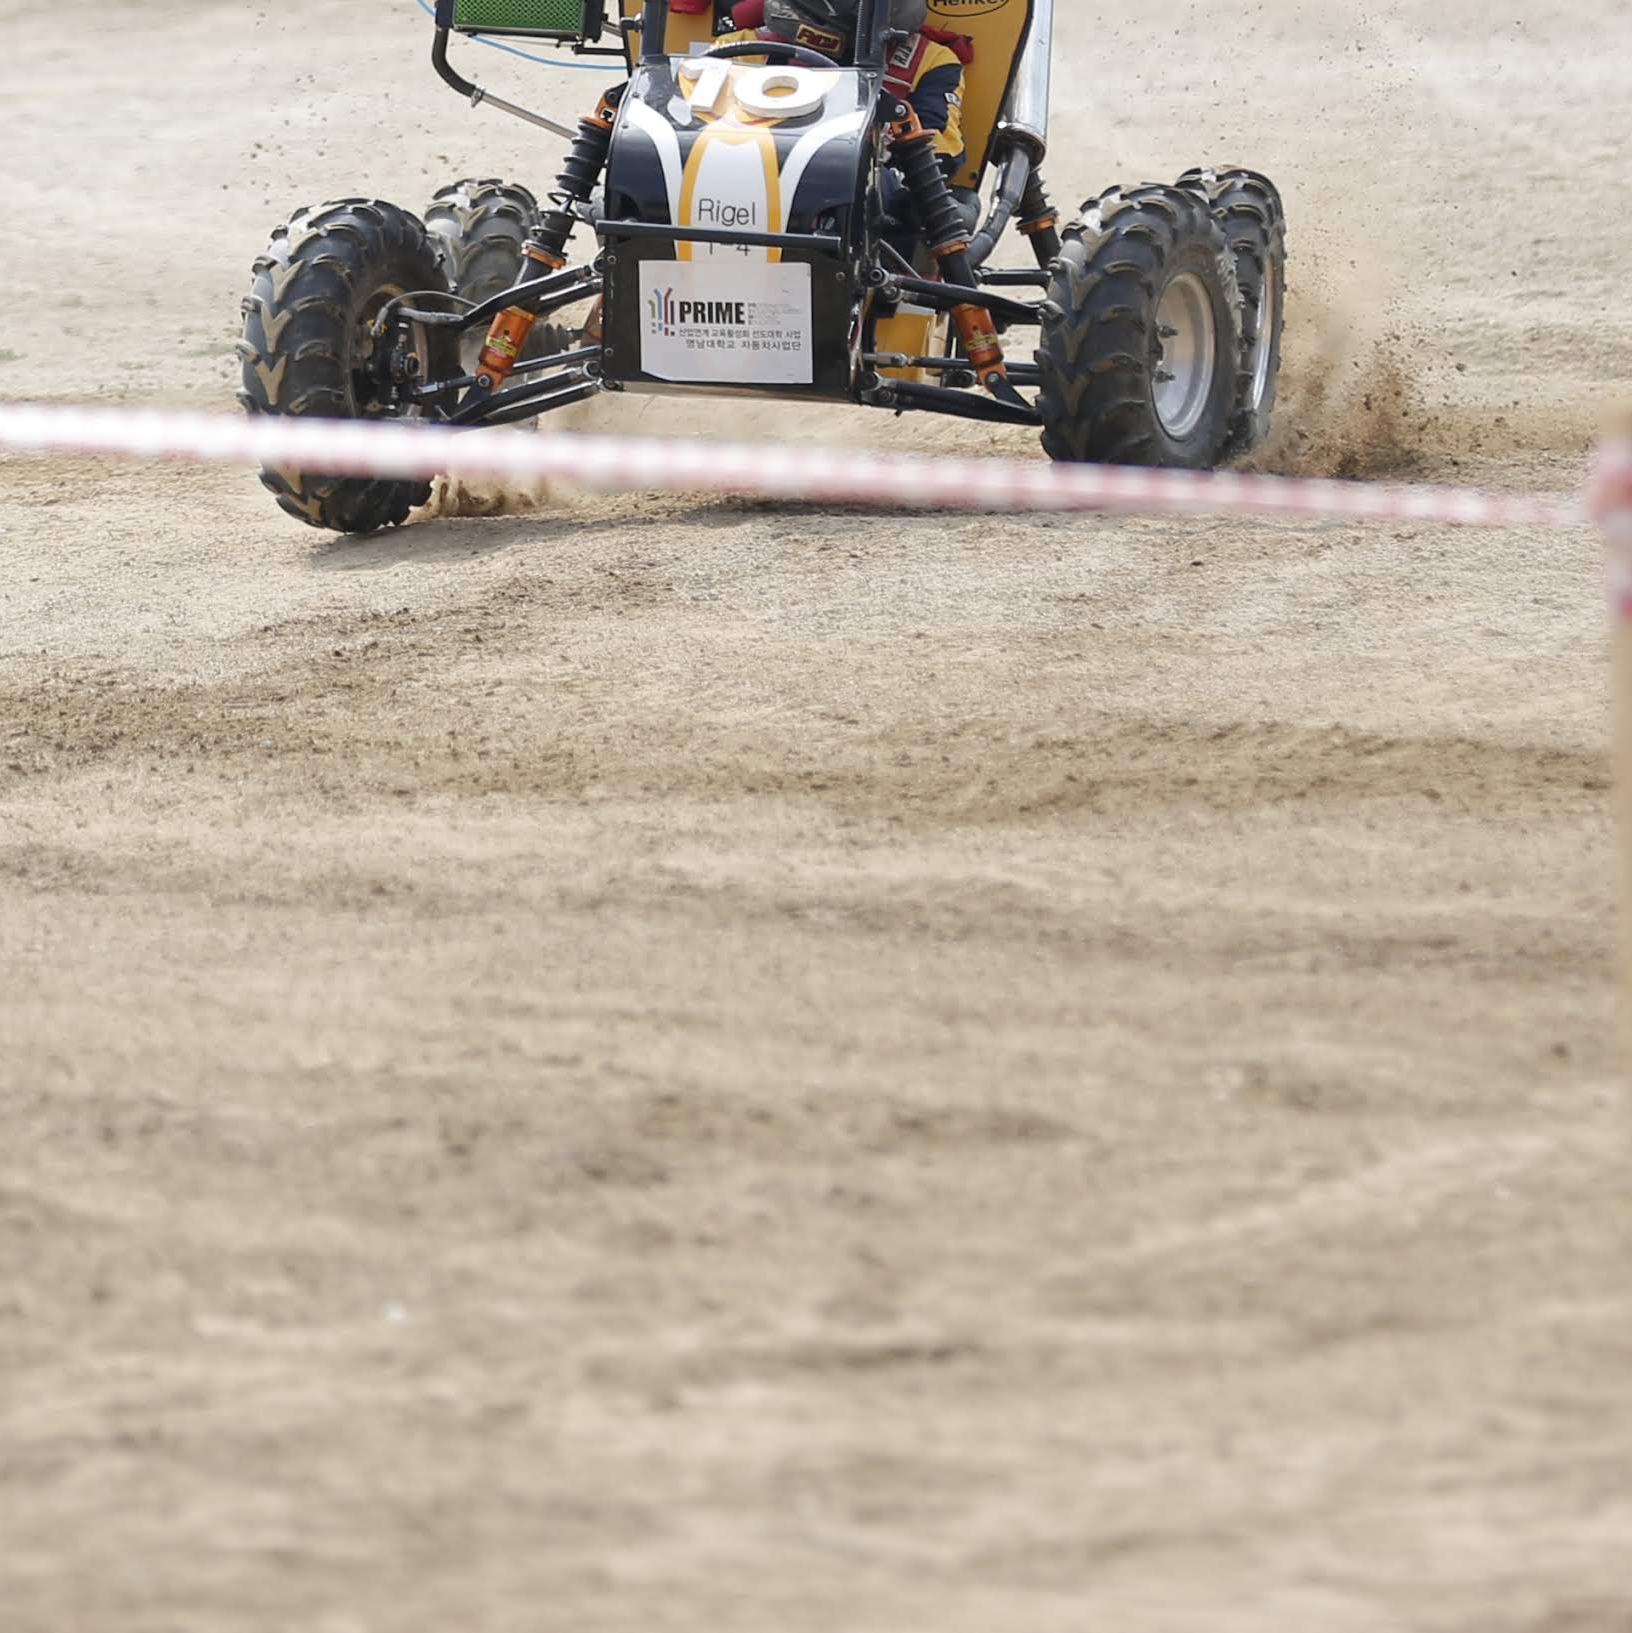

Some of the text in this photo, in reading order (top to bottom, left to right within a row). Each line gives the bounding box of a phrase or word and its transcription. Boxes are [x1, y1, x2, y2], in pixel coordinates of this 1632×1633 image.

[679, 57, 823, 119] 10
[698, 198, 756, 227] Rigel
[679, 301, 745, 325] PRIME
